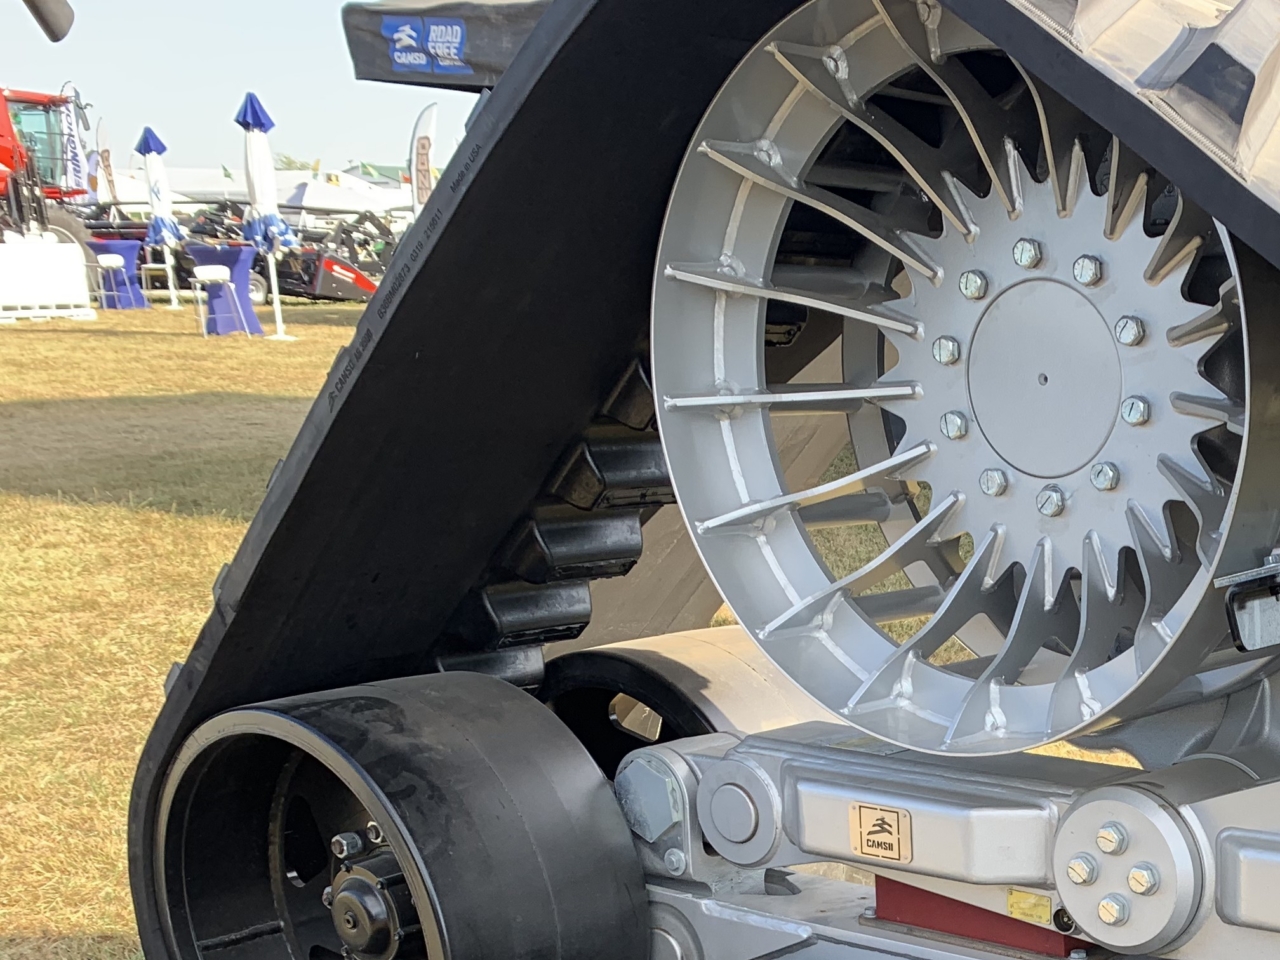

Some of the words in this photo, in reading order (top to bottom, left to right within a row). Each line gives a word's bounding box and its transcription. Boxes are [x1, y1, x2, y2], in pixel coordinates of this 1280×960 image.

[429, 25, 462, 42] ROAD
[394, 52, 427, 65] CAMSO
[427, 42, 459, 59] FREE
[449, 171, 466, 194] Made
[468, 143, 483, 163] USA
[334, 361, 355, 394] CAMSO
